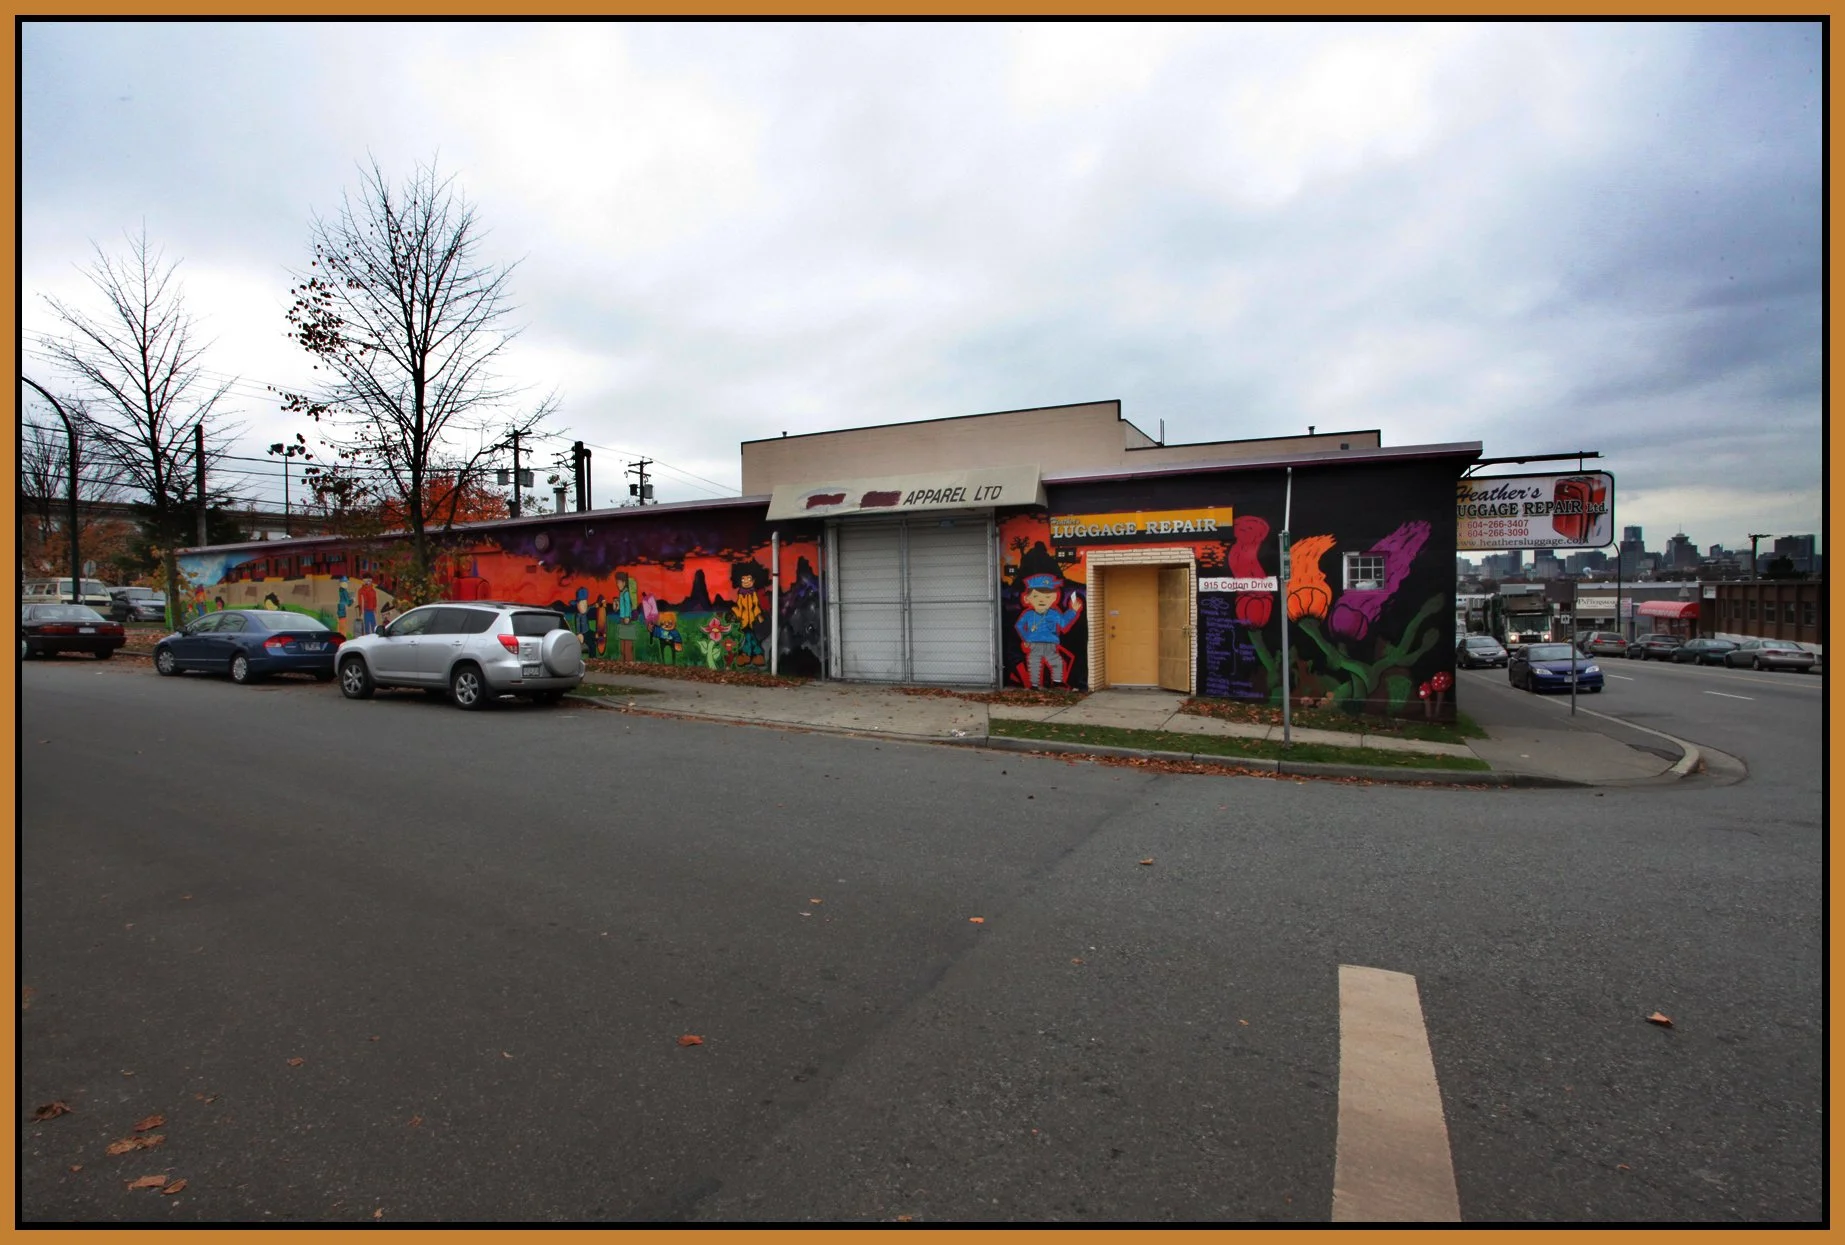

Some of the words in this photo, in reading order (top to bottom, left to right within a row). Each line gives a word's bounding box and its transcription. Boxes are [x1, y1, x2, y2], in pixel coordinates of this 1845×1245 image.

[903, 487, 966, 506] APPAREL
[974, 485, 1002, 501] LTD
[1457, 482, 1542, 503] Heather's
[1457, 502, 1519, 517] UGGAGE
[1523, 500, 1582, 515] REPAIR
[1053, 523, 1138, 539] LUGGAGE
[1146, 518, 1217, 535] REPAIR
[1467, 520, 1529, 529] 604-266-3407
[1467, 528, 1529, 538] 604-266-3090
[1203, 581, 1219, 590] 915
[1221, 581, 1249, 590] Cotton
[1251, 580, 1274, 589] Drive
